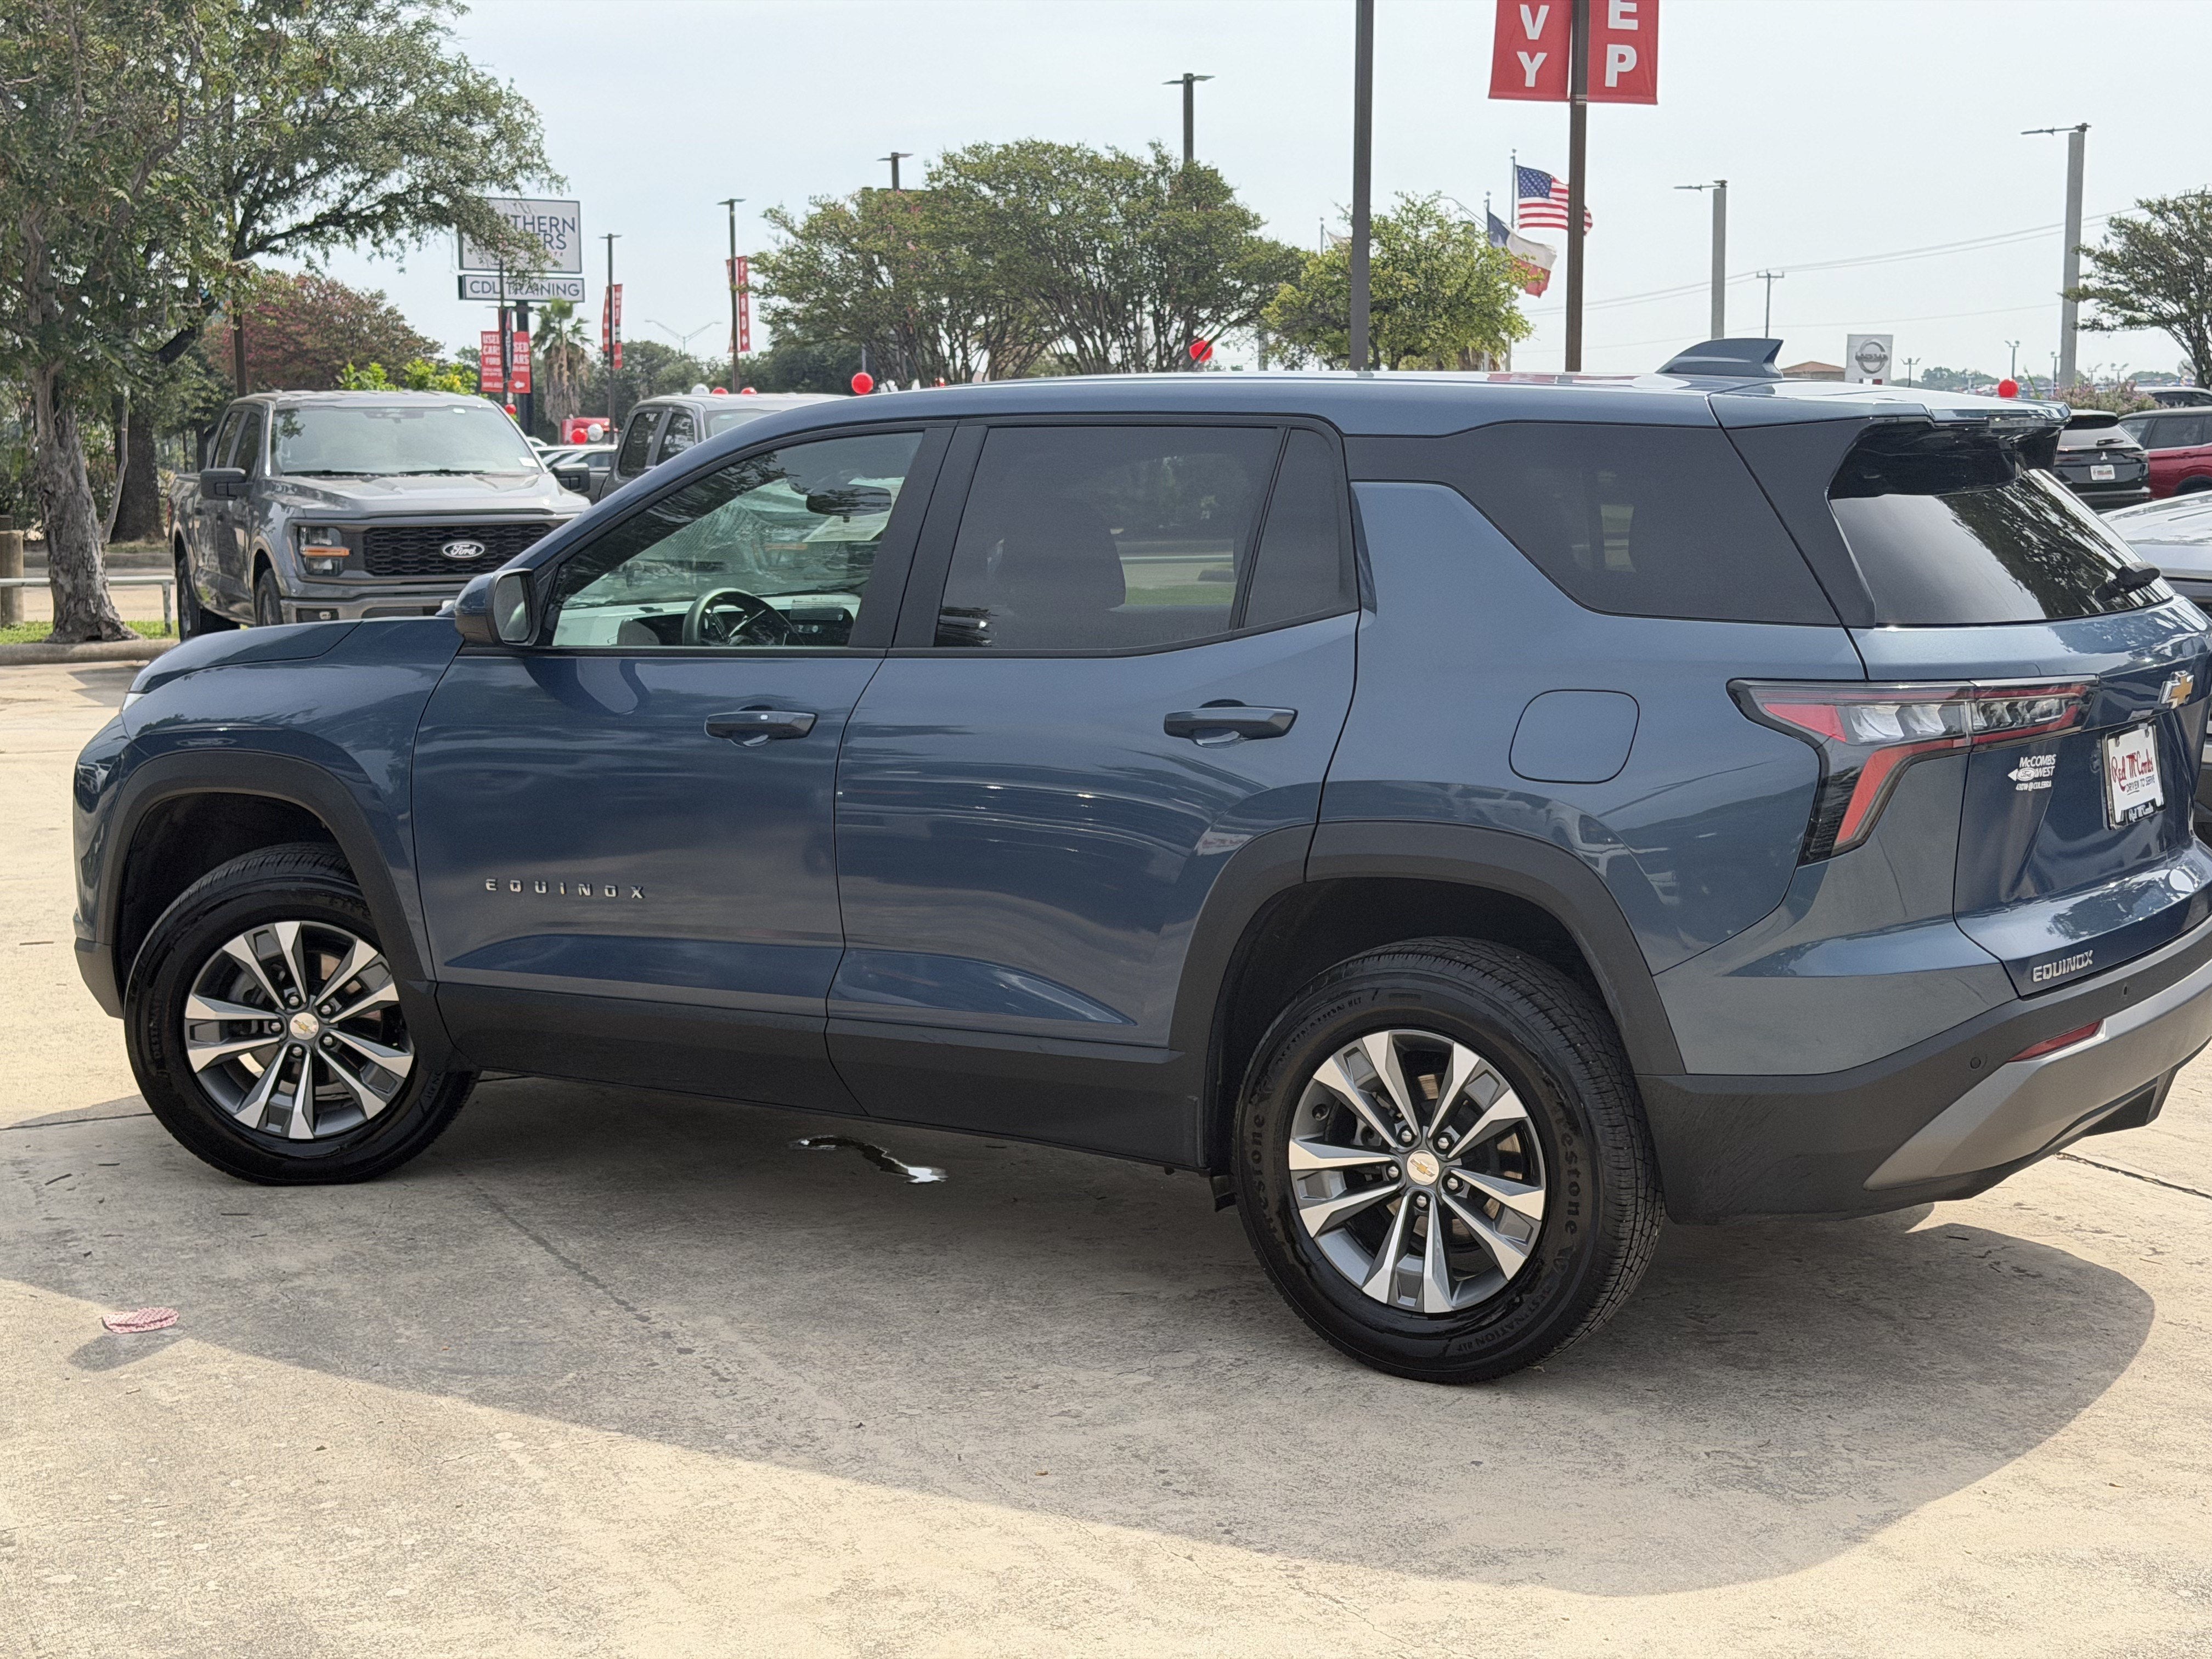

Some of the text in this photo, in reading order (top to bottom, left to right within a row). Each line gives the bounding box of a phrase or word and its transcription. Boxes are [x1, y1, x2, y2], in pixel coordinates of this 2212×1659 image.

[470, 280, 502, 294] CDL
[450, 544, 477, 556] Ford
[2019, 753, 2057, 768] McCOMBS
[2034, 766, 2056, 778] WEST
[485, 878, 645, 900] EQUINOX
[2033, 949, 2094, 982] EQUINOX
